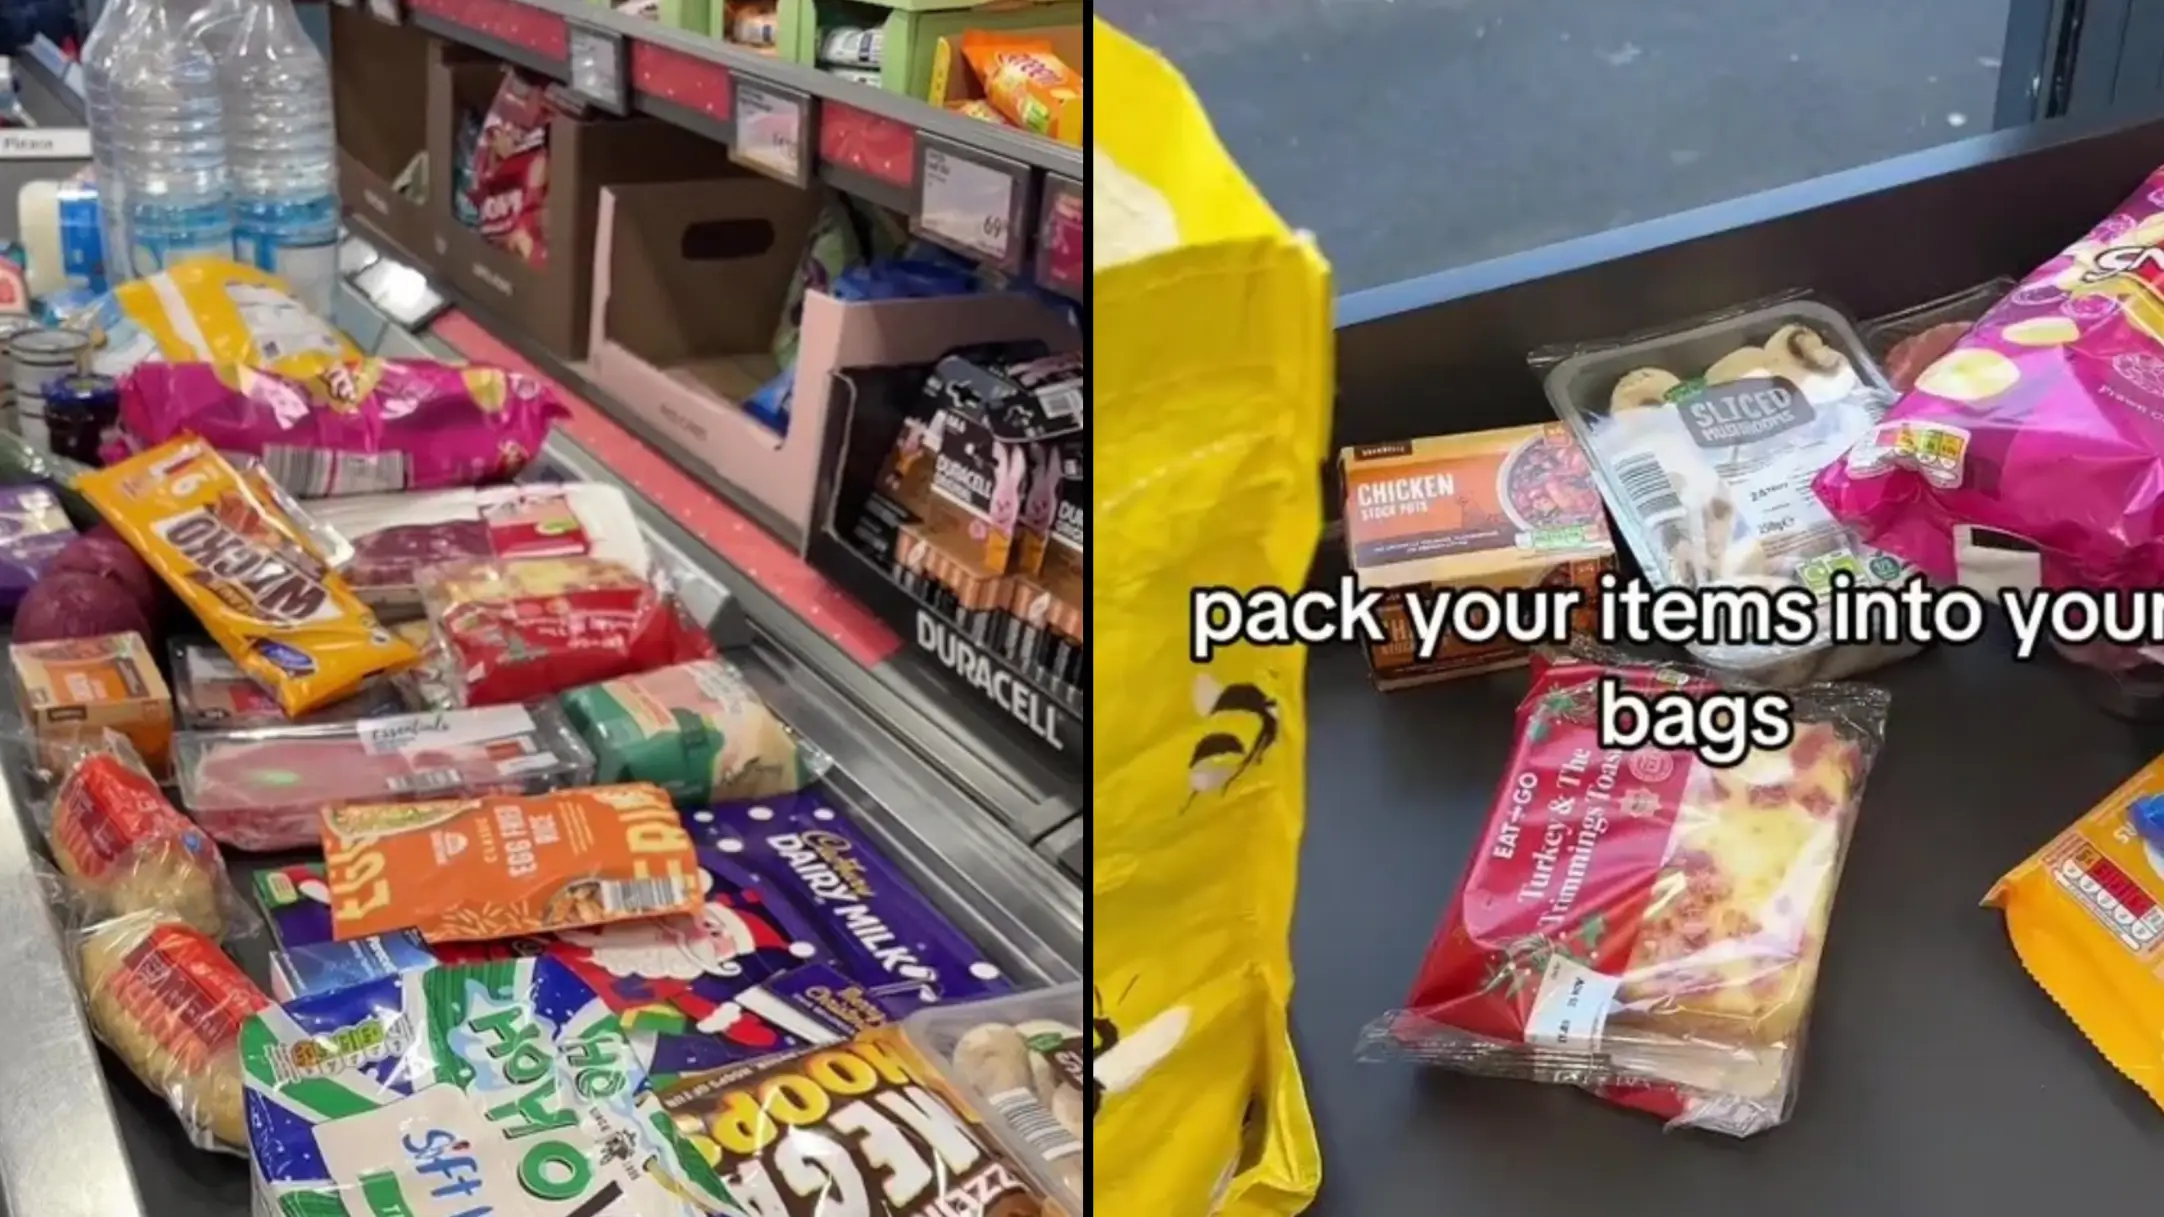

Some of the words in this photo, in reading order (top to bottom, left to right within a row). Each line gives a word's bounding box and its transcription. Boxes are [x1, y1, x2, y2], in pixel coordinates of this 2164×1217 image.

[1689, 387, 1793, 427] SLICED
[1700, 409, 1796, 441] MUSHROOMS
[934, 453, 994, 499] DURACELL
[1356, 473, 1456, 507] CHICKEN
[1360, 503, 1396, 522] STOCK
[1399, 500, 1430, 516] POTS
[916, 608, 1064, 751] DURACELL
[1556, 748, 1592, 789] The
[1547, 796, 1576, 815] &
[504, 838, 538, 878] EGG
[1517, 818, 1574, 903] Turkey
[1537, 806, 1609, 928] Trimmings
[765, 832, 861, 902] DAIRY
[832, 903, 919, 973] MILK
